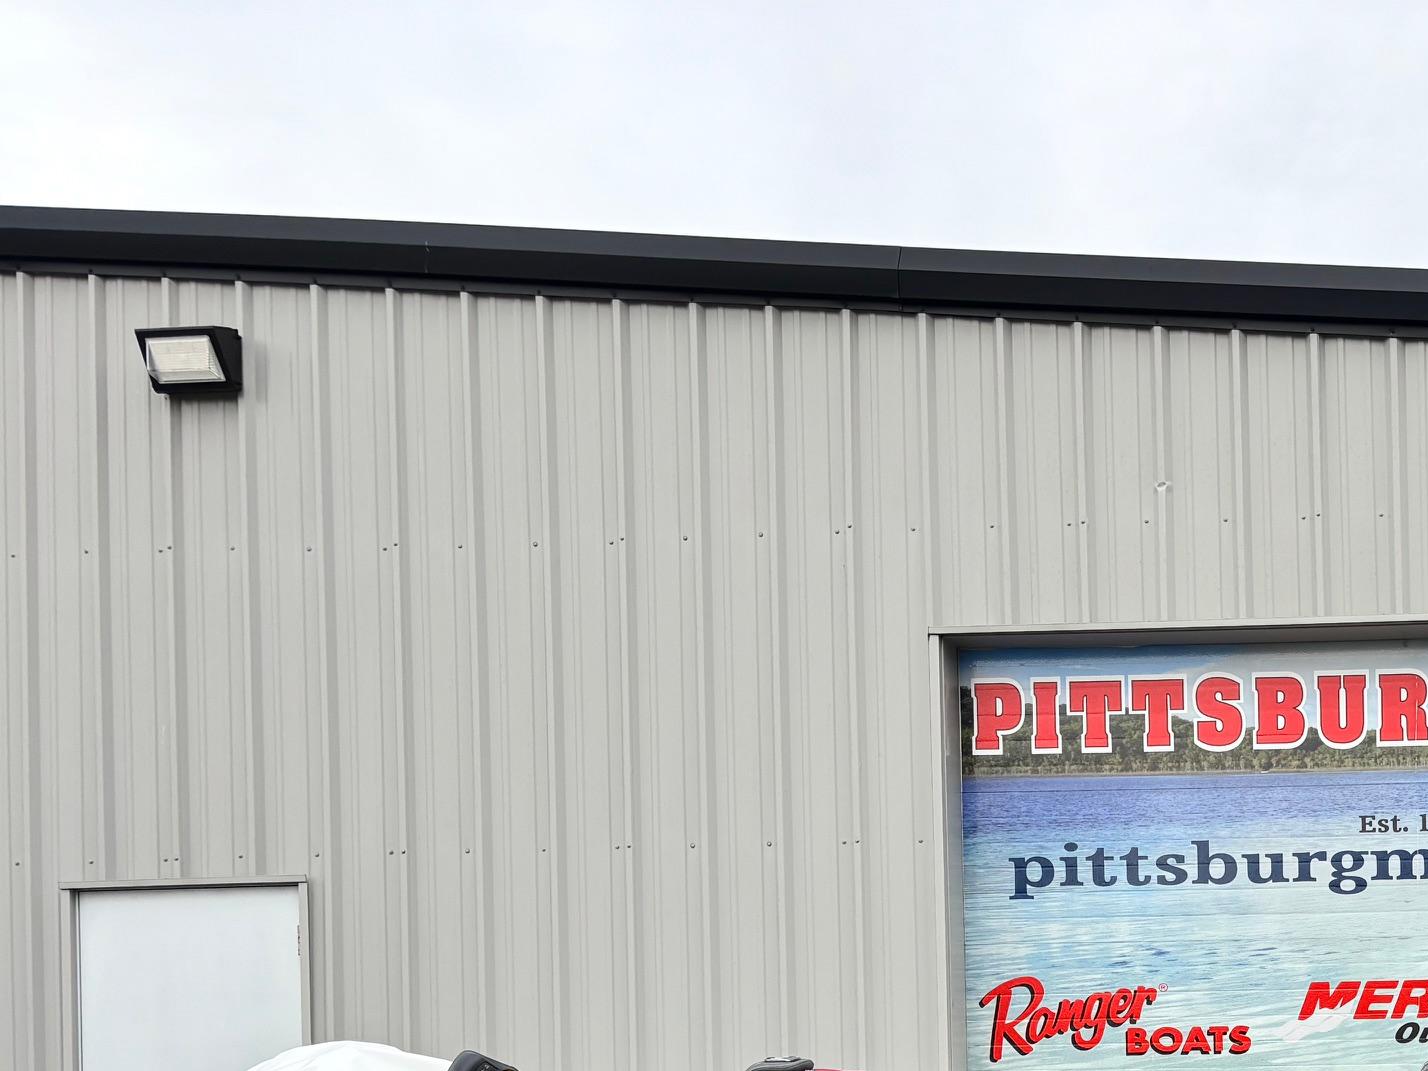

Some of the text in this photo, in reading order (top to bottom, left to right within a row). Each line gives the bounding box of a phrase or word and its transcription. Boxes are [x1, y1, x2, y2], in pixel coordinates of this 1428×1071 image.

[1358, 815, 1409, 833] Est.
[979, 976, 1157, 1062] Ranger
[1126, 1025, 1252, 1056] BOATS
